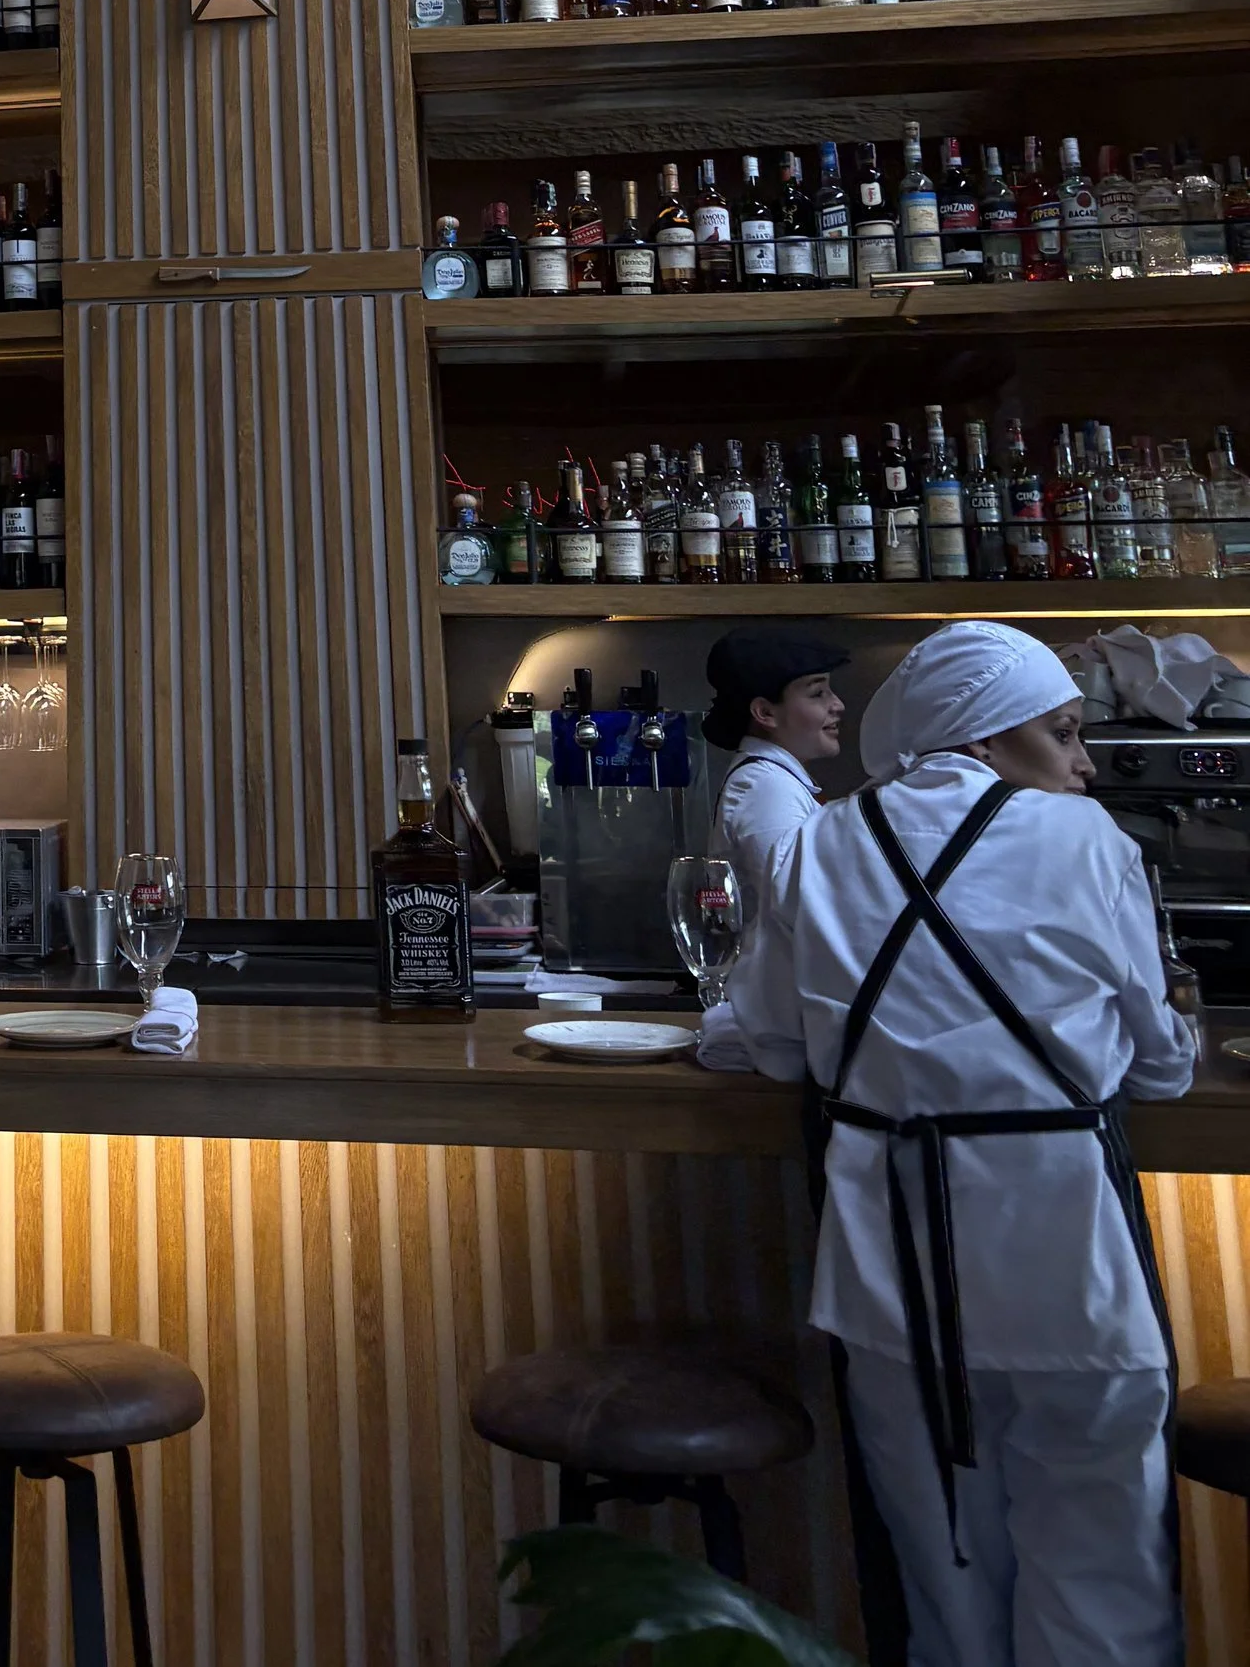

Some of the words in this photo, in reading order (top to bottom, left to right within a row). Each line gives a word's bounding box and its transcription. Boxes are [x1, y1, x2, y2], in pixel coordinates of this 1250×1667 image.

[385, 892, 414, 915] JACK
[414, 886, 460, 915] DANIEL'S
[412, 916, 434, 924] No.7
[399, 931, 449, 944] Tennessee
[400, 949, 449, 958] WHISKEY
